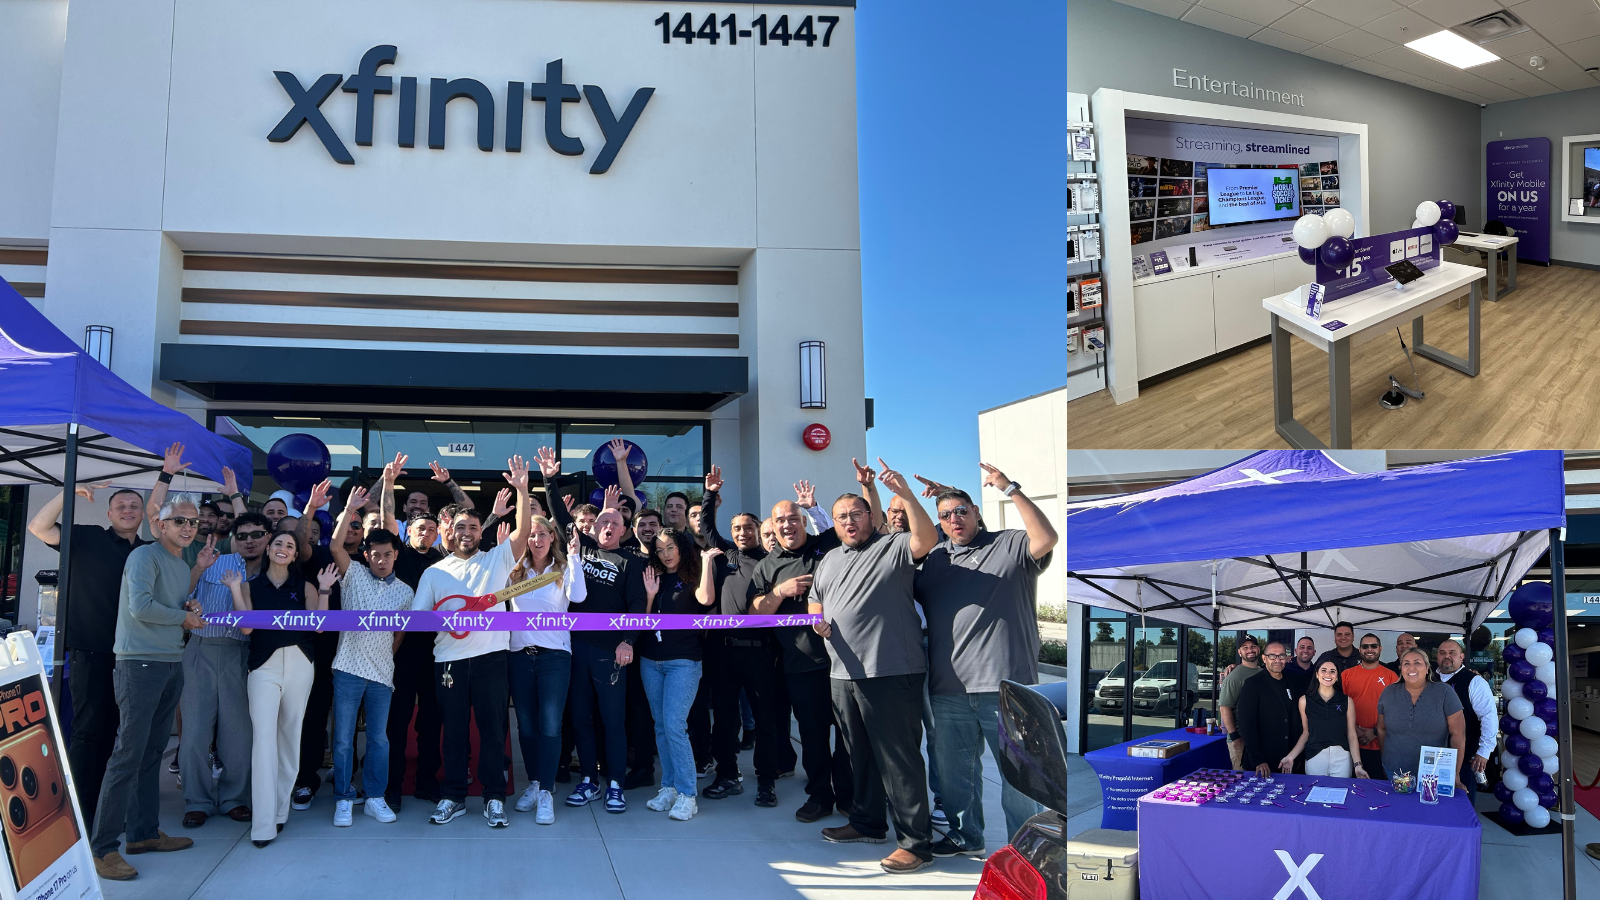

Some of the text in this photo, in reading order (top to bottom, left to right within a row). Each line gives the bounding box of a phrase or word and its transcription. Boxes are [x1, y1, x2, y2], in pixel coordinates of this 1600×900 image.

[654, 12, 840, 47] 1441-1447
[1172, 68, 1305, 107] Entertainment
[266, 45, 656, 174] xfinity
[1176, 136, 1310, 155] Streaming, streamlined
[1508, 170, 1524, 179] Get
[1490, 180, 1546, 189] Xfinity Mobile
[1497, 191, 1538, 202] ON US
[1498, 203, 1508, 211] for
[1518, 205, 1537, 213] year
[449, 443, 475, 453] 1447
[502, 576, 546, 596] GRAND OPENING
[200, 612, 244, 627] finity
[272, 611, 326, 629] xfinity
[357, 611, 411, 630] xfinity
[442, 612, 495, 630] xfinity
[526, 613, 578, 630] xfinity
[608, 614, 661, 629] xfinity
[692, 615, 745, 629] xfinity
[0, 689, 16, 701] Phone
[0, 690, 47, 733] RO
[58, 875, 67, 887] Pro
[1082, 873, 1098, 881] YETI
